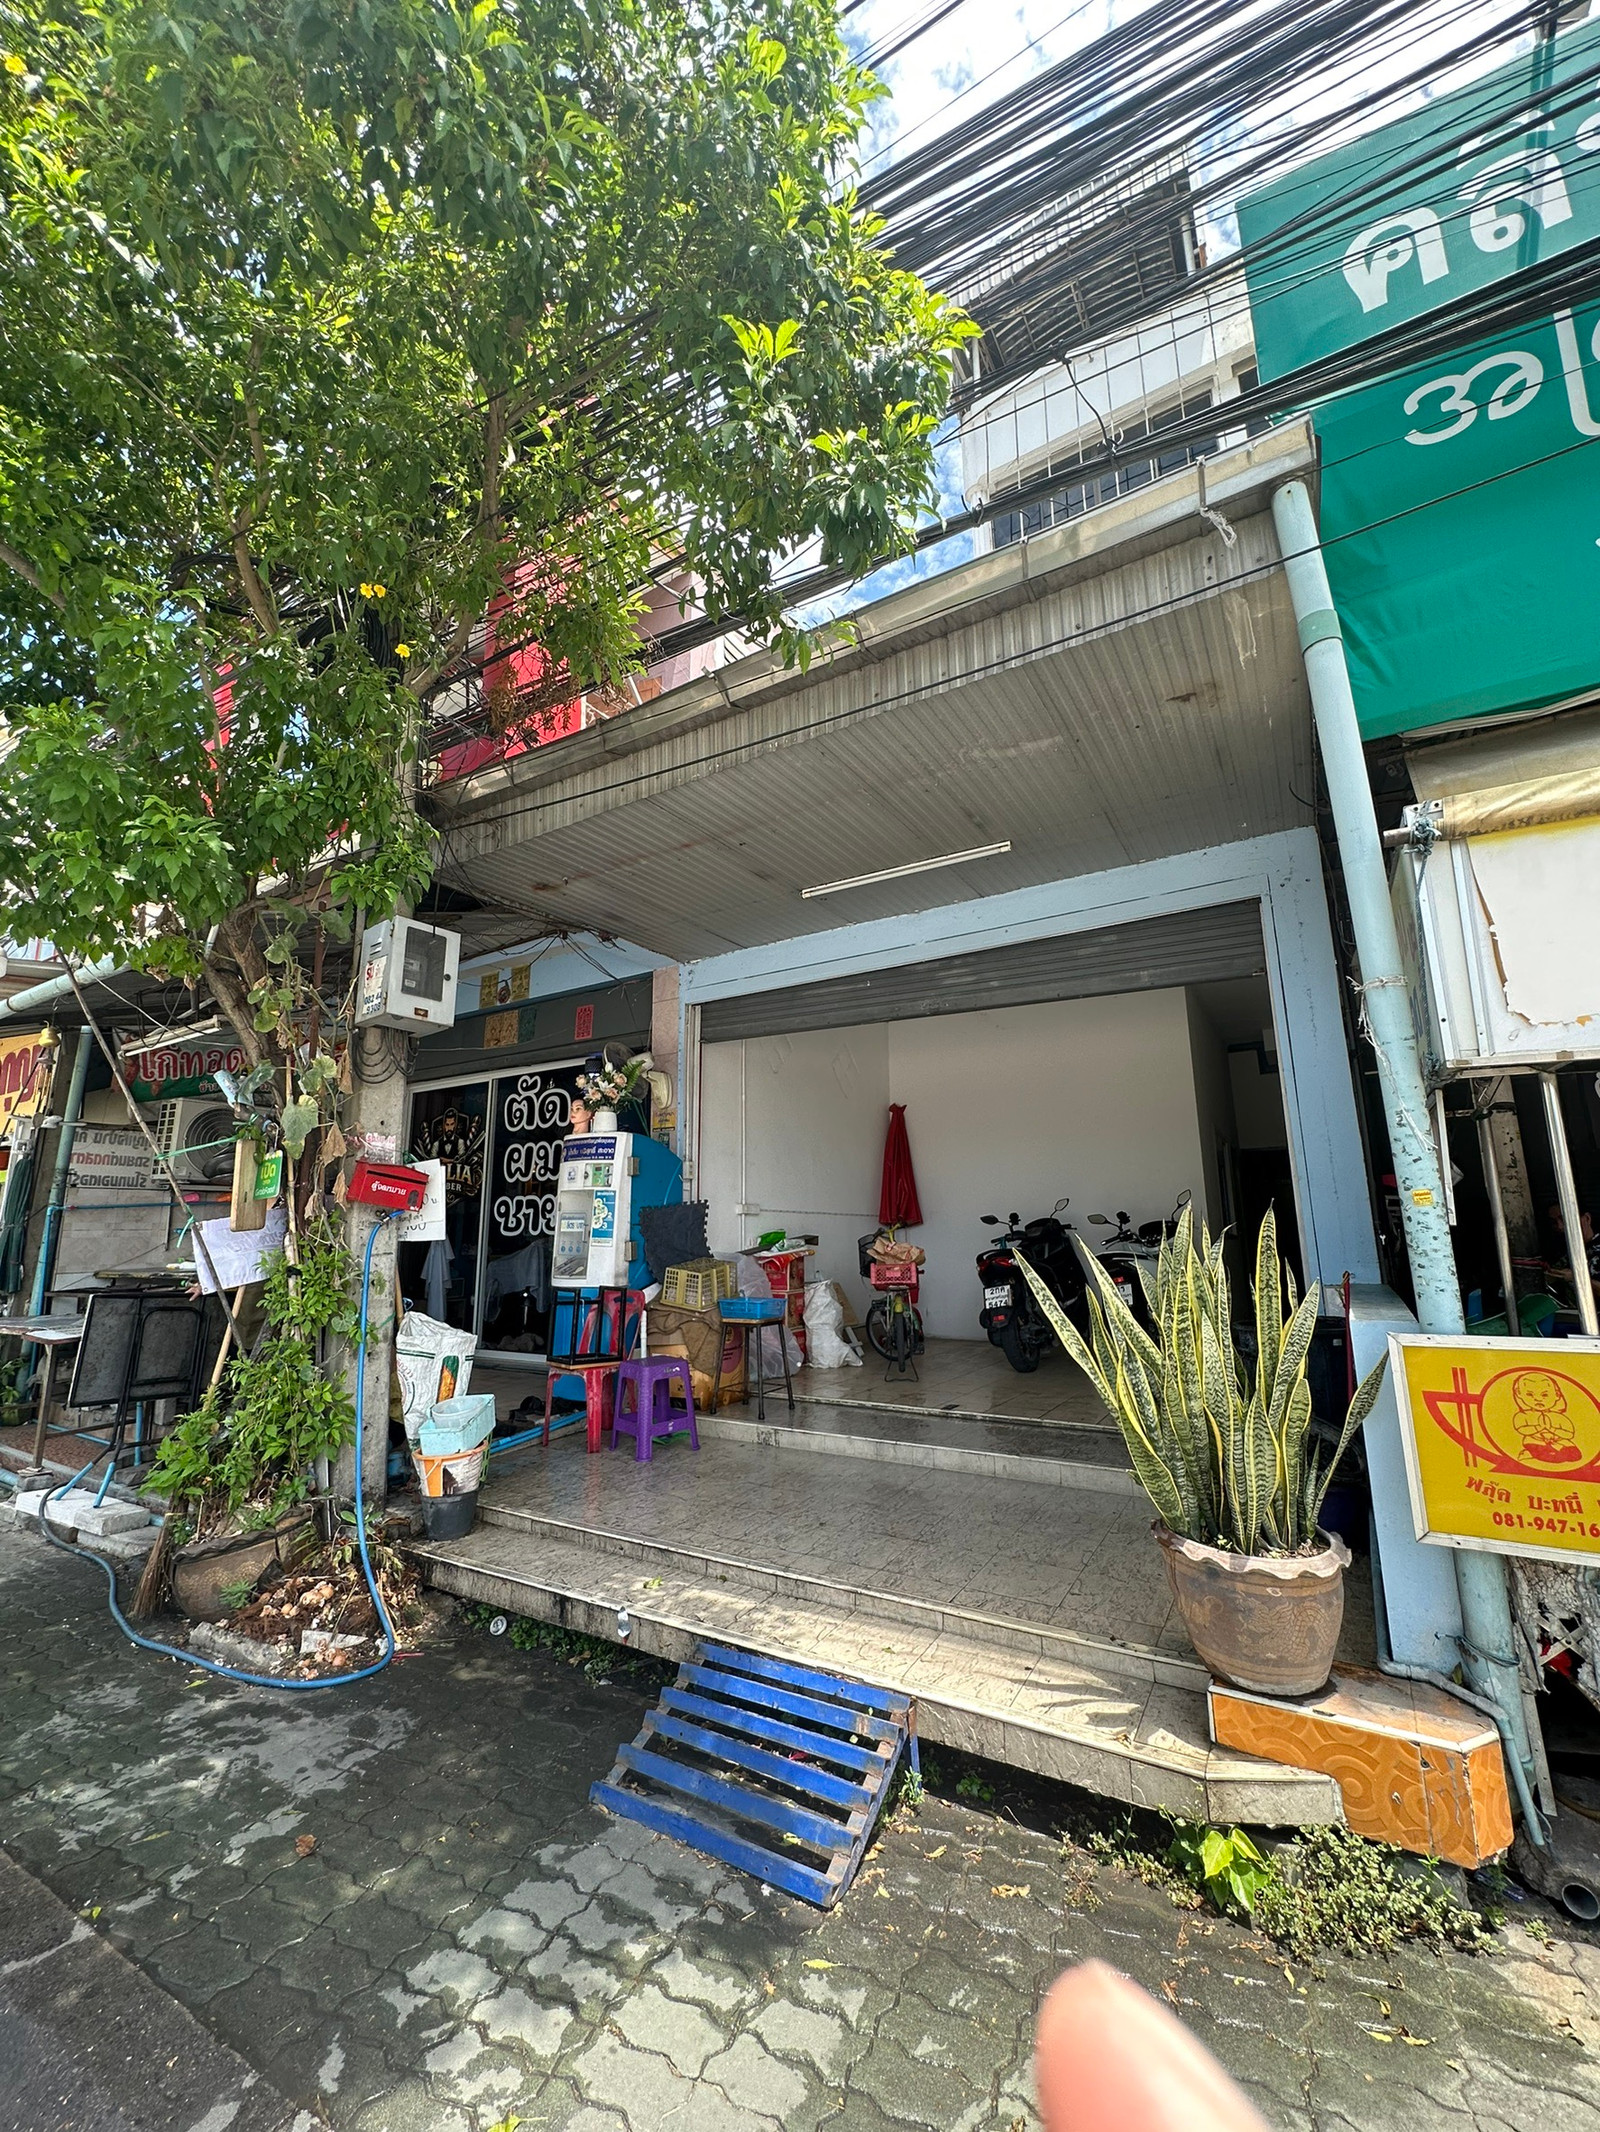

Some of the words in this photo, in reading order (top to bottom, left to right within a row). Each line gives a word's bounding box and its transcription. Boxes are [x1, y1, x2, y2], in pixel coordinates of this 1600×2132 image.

[504, 1075, 571, 1132] ตัด
[503, 1139, 564, 1183] ผม
[371, 1180, 407, 1196] ตู้จดหมาย
[1492, 1511, 1600, 1538] 081-947-16
